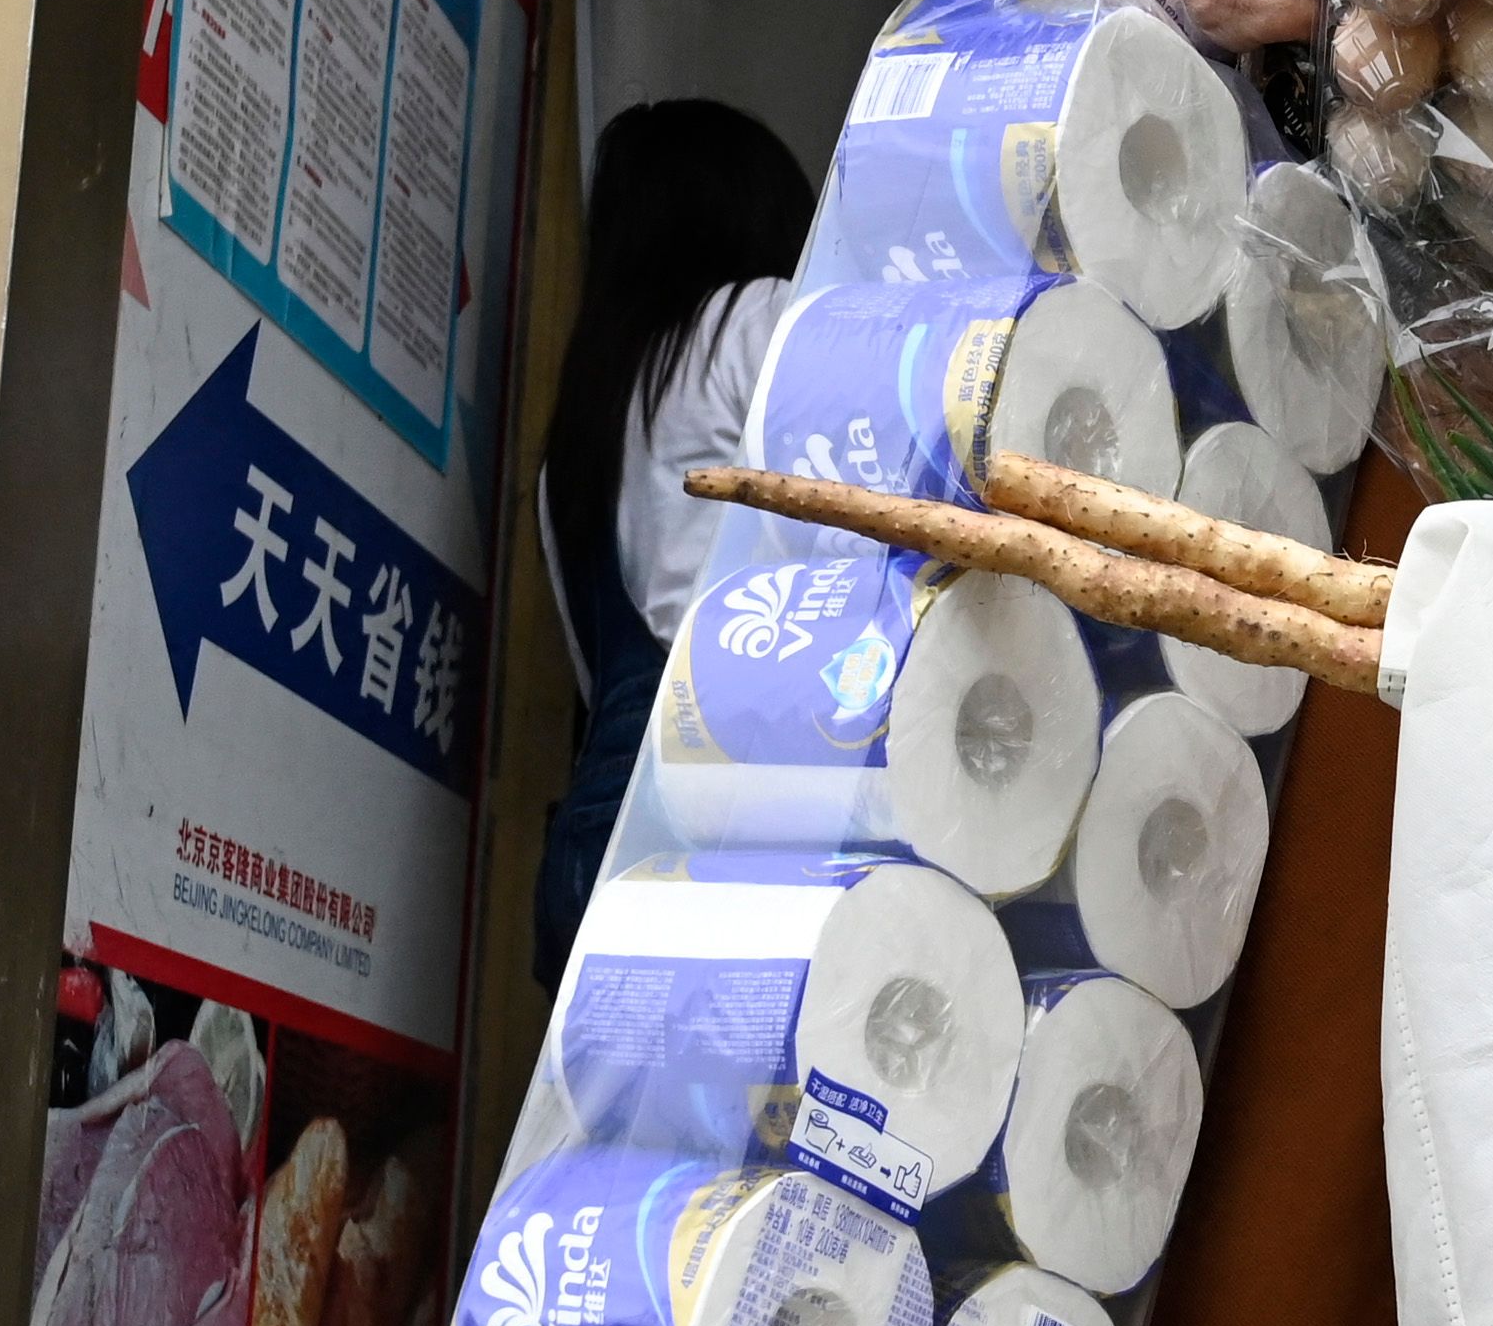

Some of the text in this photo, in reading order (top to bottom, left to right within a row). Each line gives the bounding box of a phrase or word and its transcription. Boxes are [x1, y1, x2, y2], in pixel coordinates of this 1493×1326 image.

[220, 463, 465, 758] 天天省钱
[823, 576, 858, 618] 维达
[173, 873, 372, 978] BEIJING JINGKELONG COMPANY LIMITED
[176, 817, 376, 945] 北京京客隆商业集团股份有限公司
[584, 1257, 612, 1326] 维达
